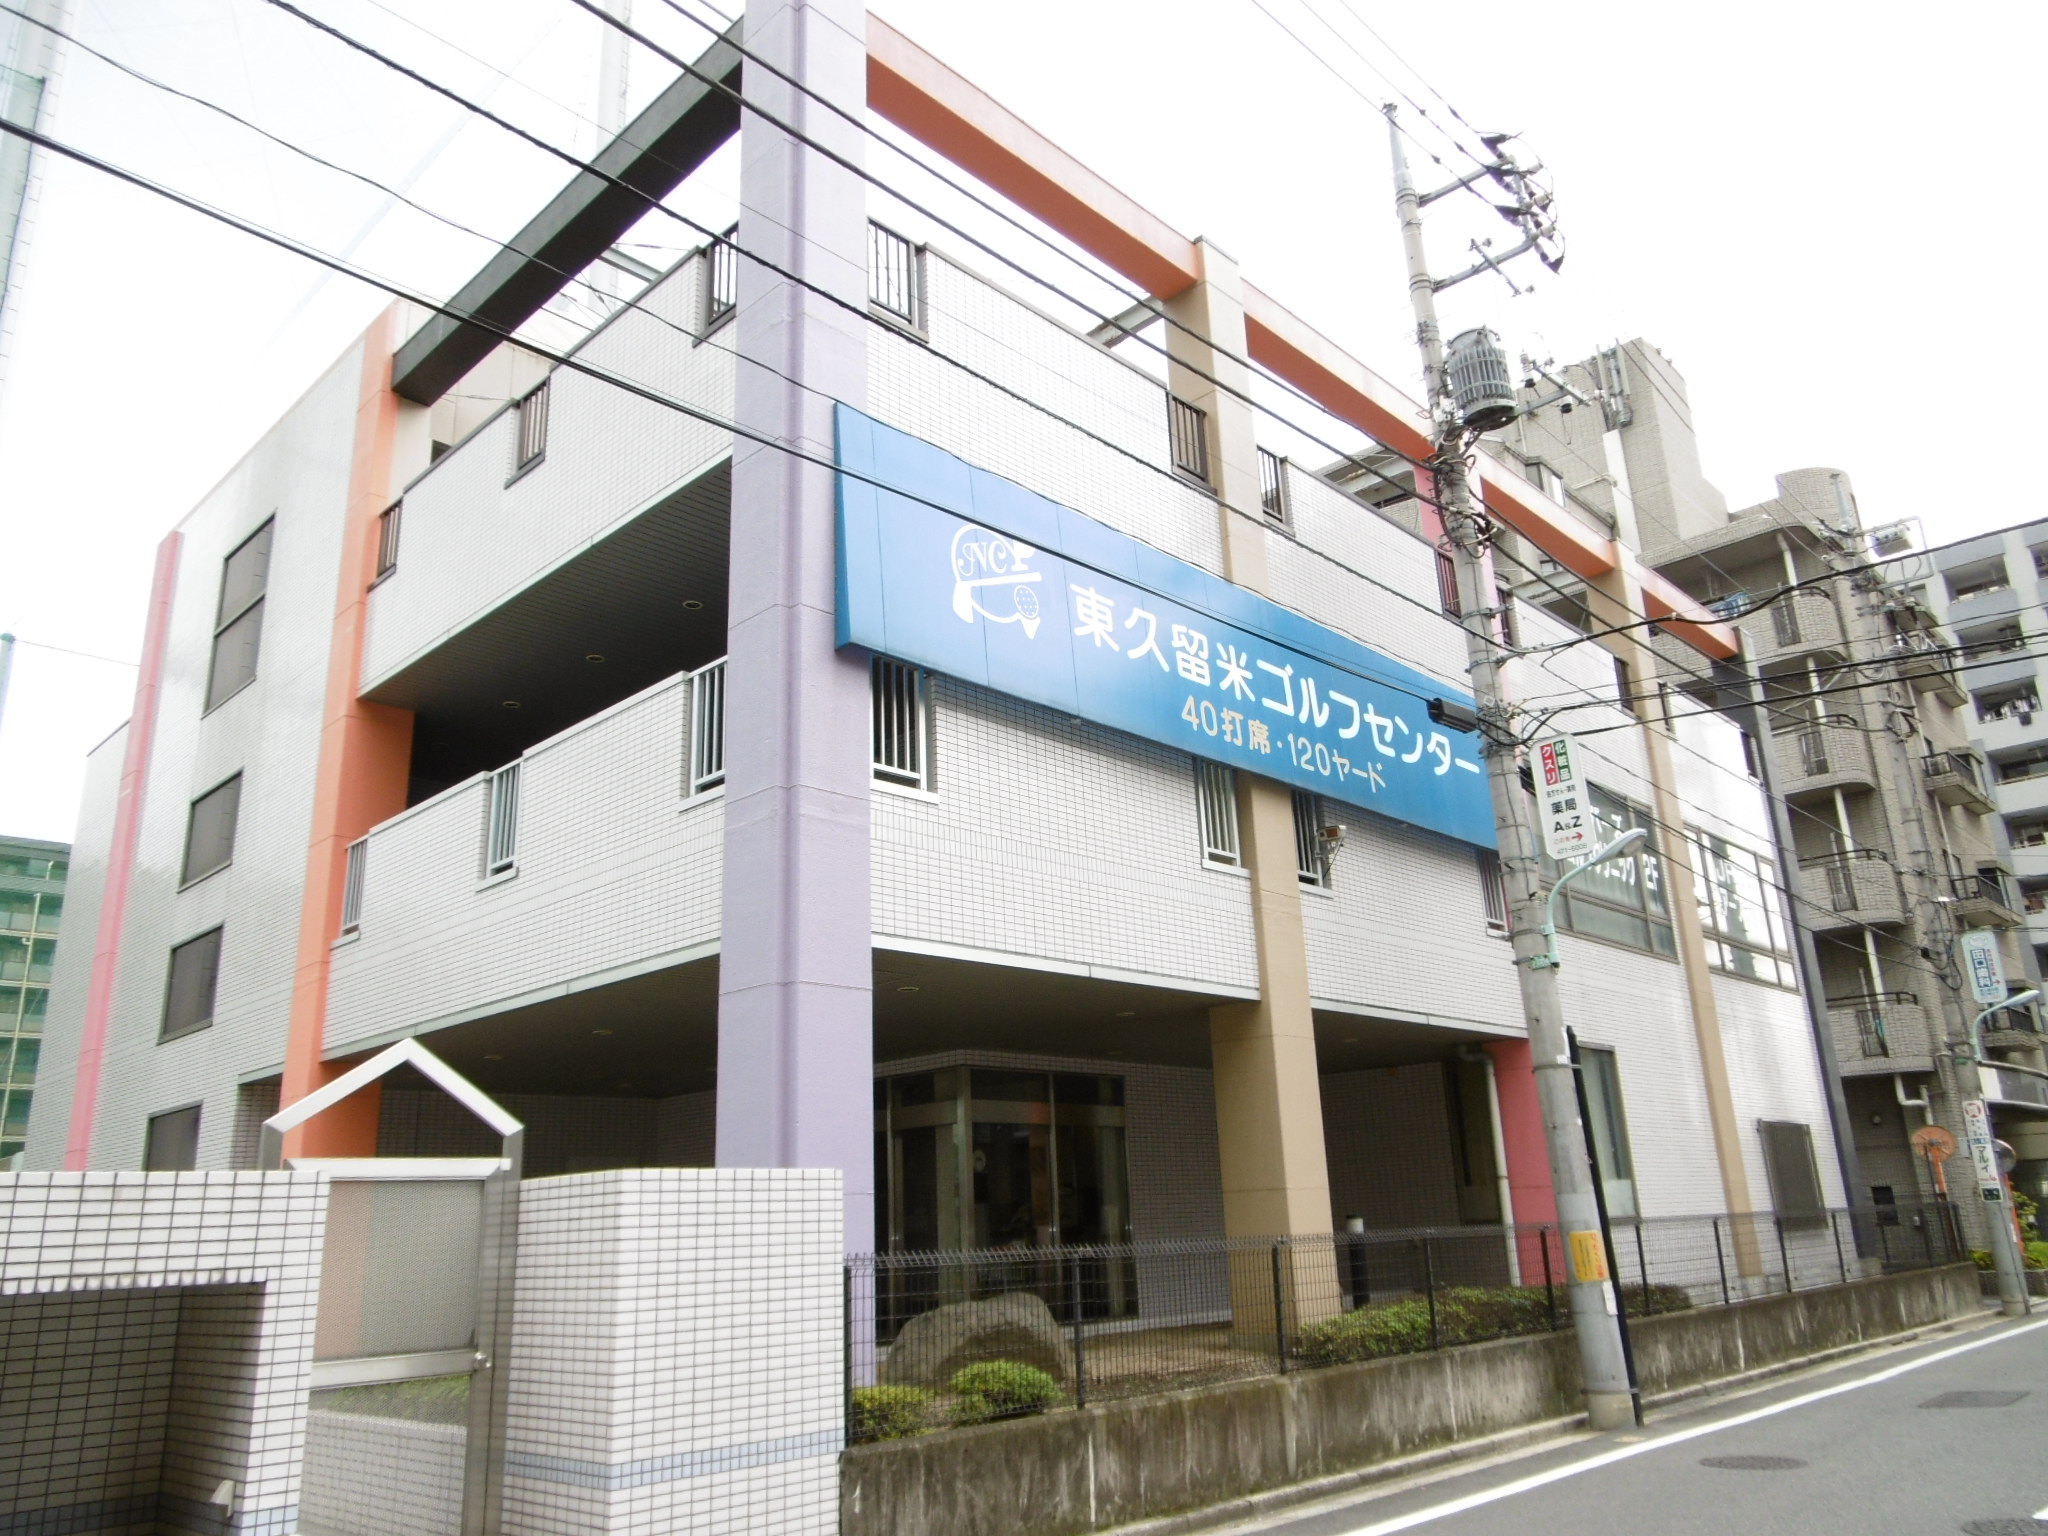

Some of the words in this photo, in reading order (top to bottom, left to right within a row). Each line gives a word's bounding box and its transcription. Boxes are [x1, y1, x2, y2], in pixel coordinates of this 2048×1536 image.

[1070, 583, 1480, 776] 東久留米ゴルフセンター
[1541, 745, 1557, 785] クスリ
[1551, 798, 1577, 815] 薬局
[1554, 815, 1583, 833] A&Z
